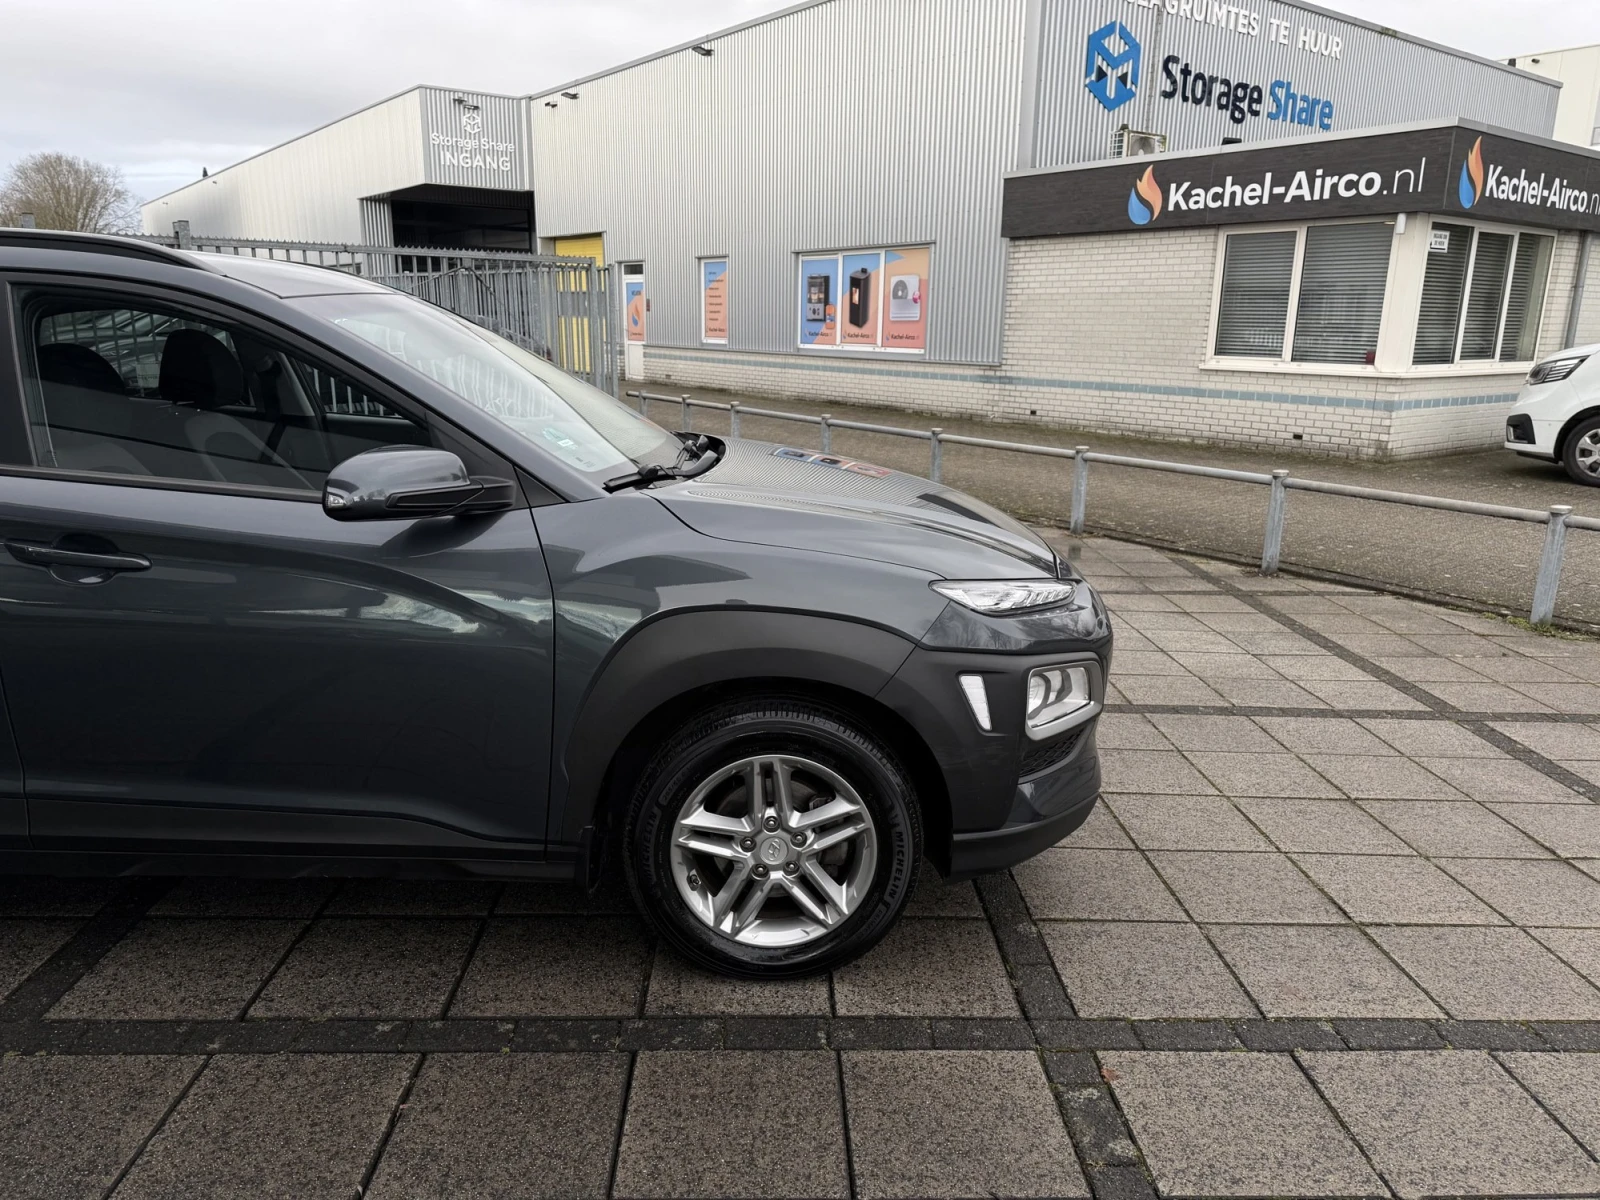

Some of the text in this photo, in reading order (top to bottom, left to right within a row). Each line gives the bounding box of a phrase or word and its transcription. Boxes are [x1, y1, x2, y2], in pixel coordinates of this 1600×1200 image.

[1269, 17, 1290, 45] TE
[1298, 27, 1342, 60] HUUR
[1161, 55, 1333, 131] Storage Share
[431, 132, 515, 152] Storage Share
[440, 151, 511, 171] INGANG
[1167, 156, 1426, 212] Kachel-Airco.nl
[1485, 163, 1600, 216] Kachel-Airco.n
[641, 810, 657, 880] MICHELIN
[888, 831, 905, 900] MICHELIN
